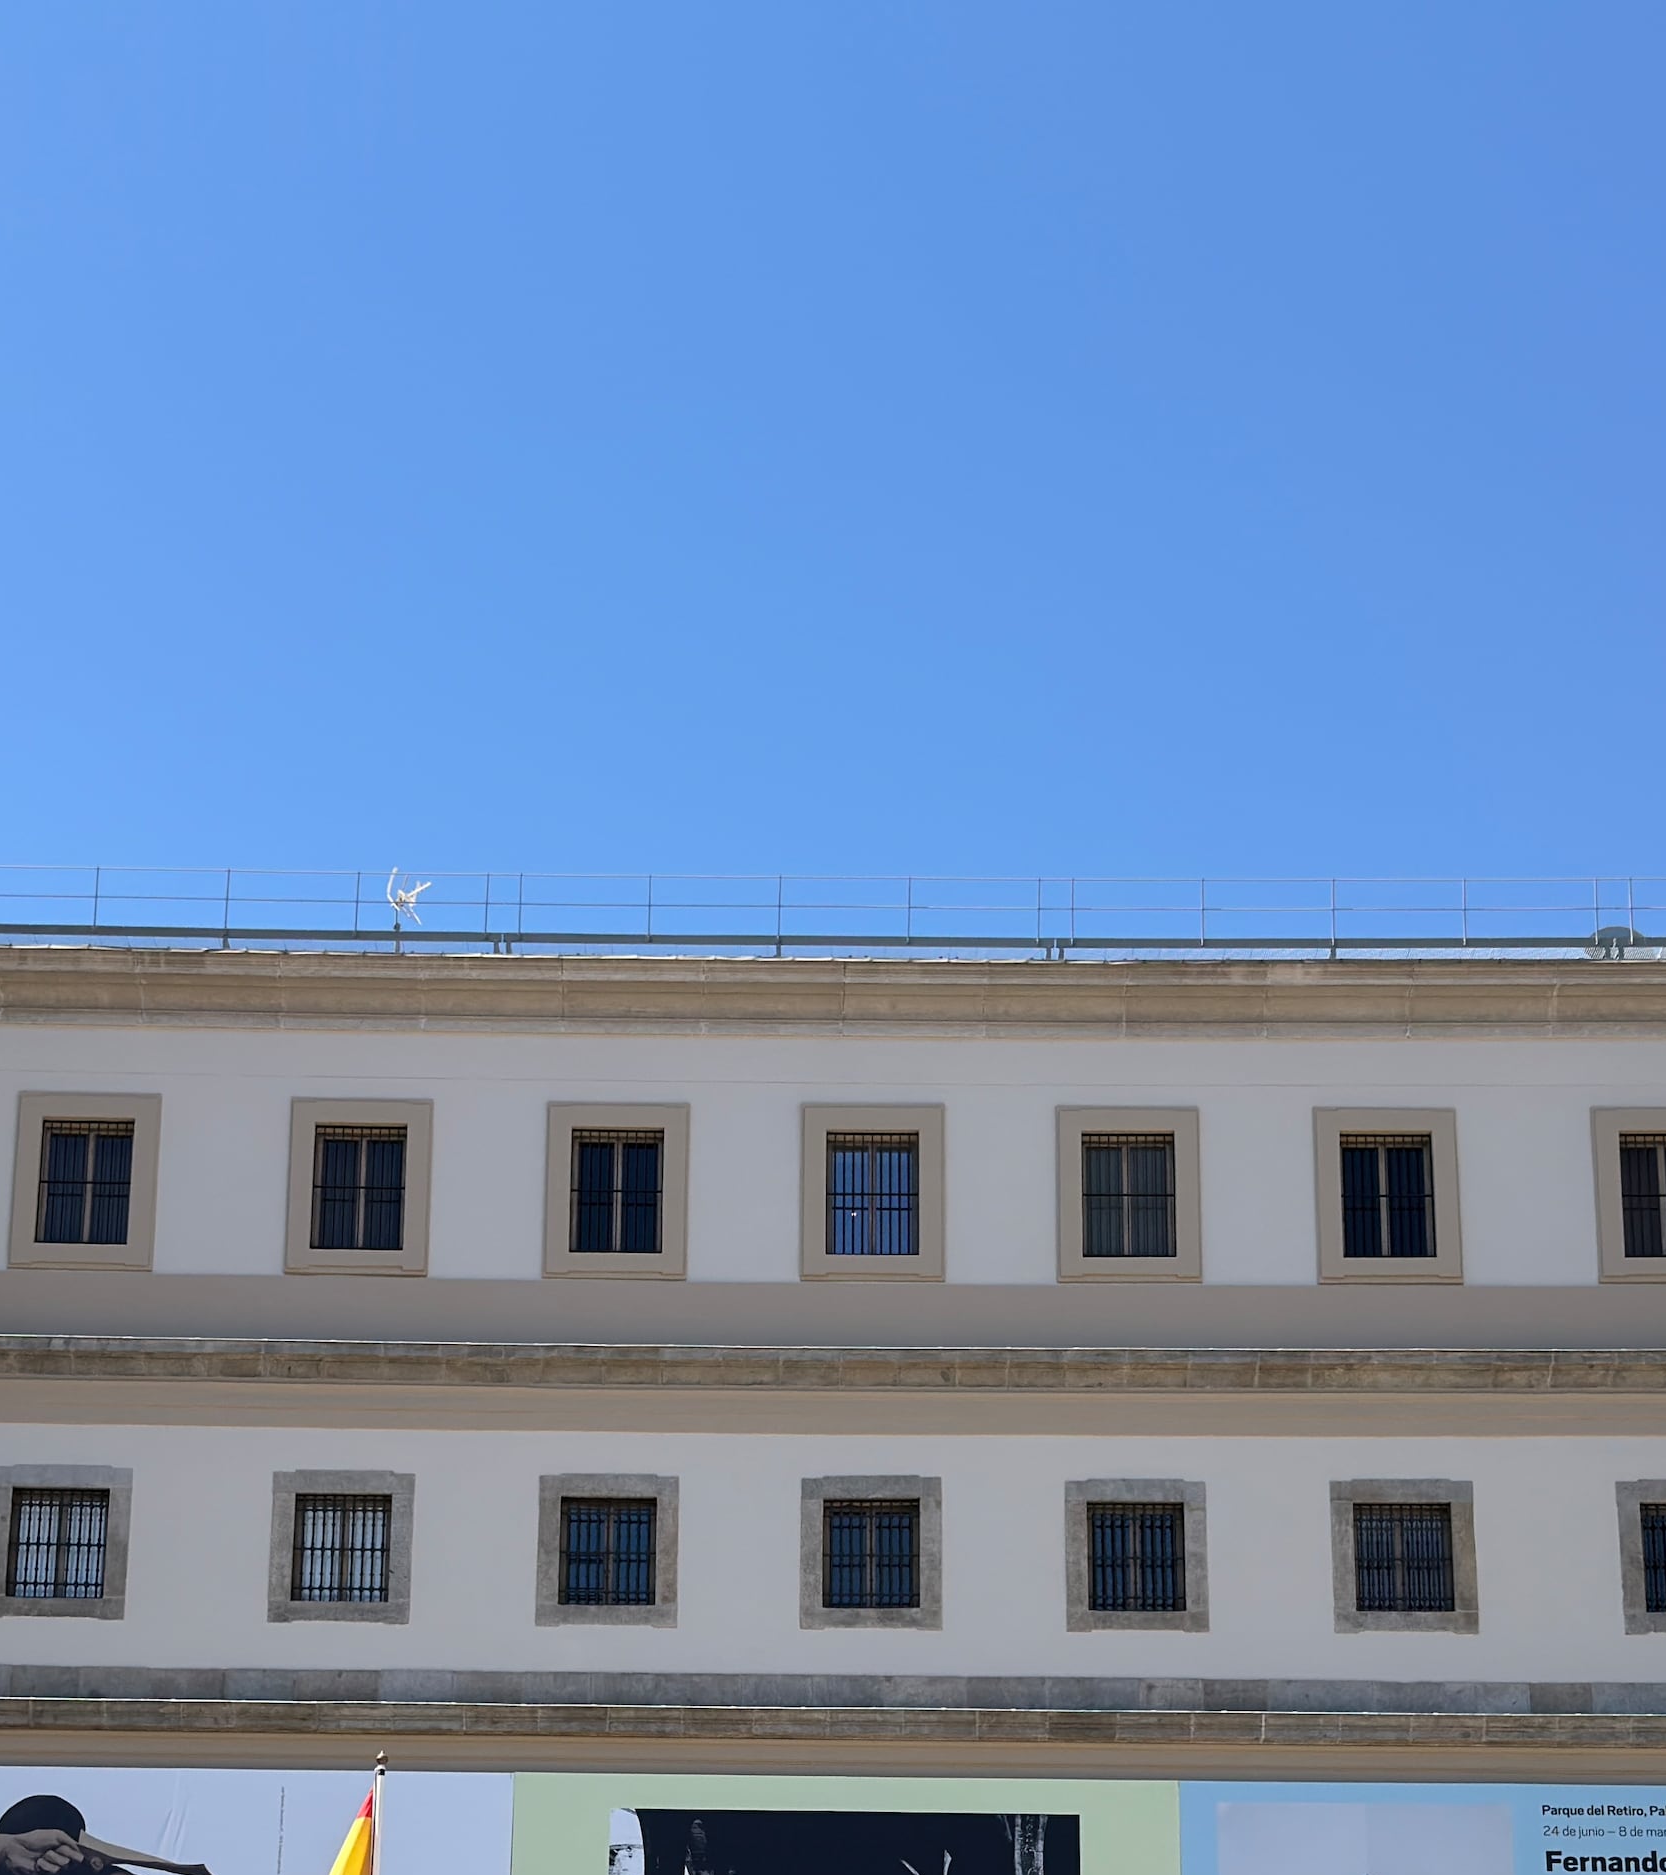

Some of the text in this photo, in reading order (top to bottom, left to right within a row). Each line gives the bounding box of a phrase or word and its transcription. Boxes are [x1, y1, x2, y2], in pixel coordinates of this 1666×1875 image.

[1542, 1804, 1584, 1818] Parque
[1587, 1804, 1605, 1816] del
[1607, 1805, 1647, 1817] Retiro,
[1543, 1825, 1559, 1836] 24
[1562, 1825, 1576, 1837] de
[1578, 1826, 1605, 1840] junio
[1619, 1826, 1627, 1837] 8
[1629, 1826, 1643, 1837] de
